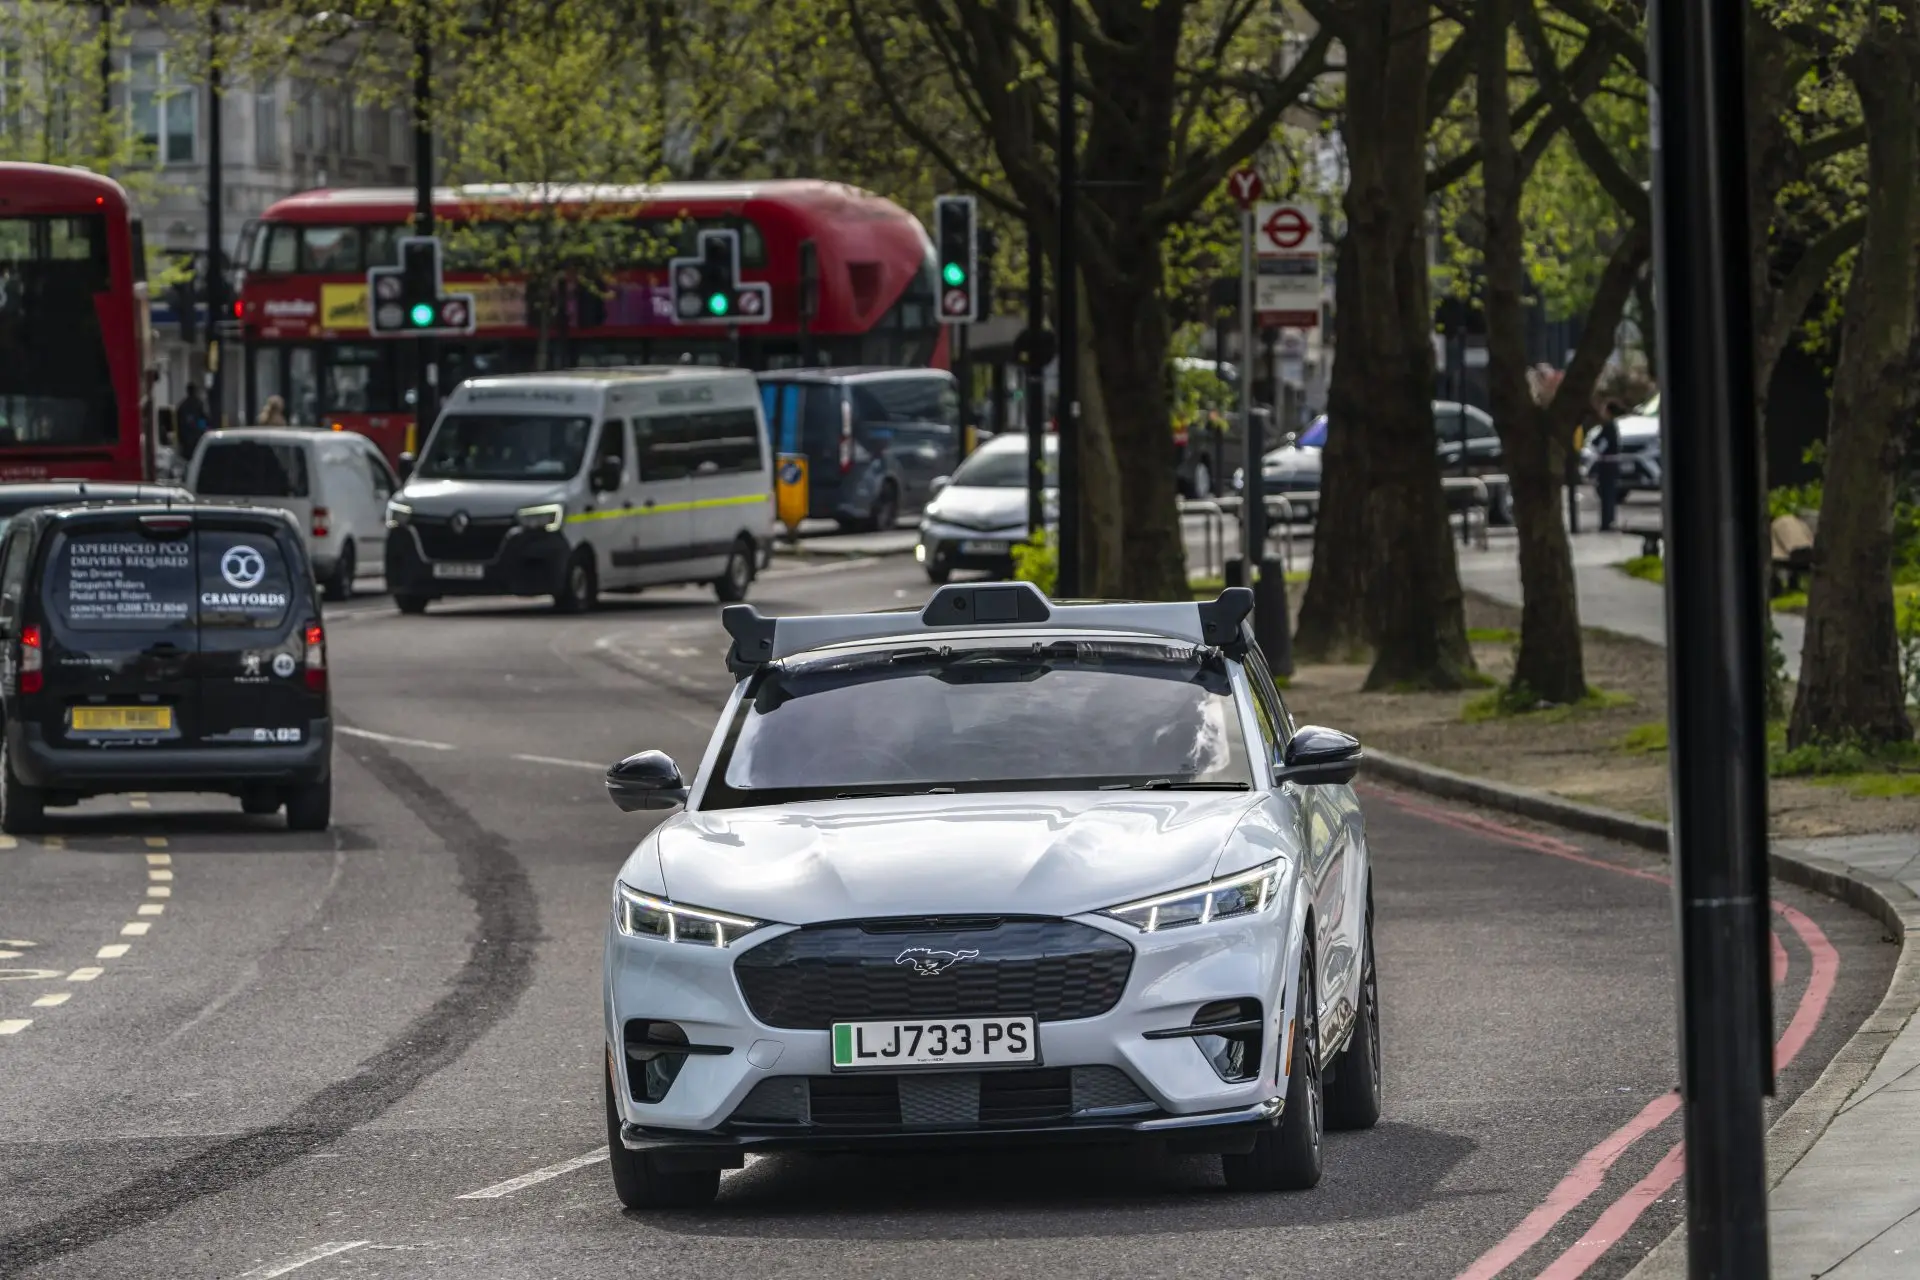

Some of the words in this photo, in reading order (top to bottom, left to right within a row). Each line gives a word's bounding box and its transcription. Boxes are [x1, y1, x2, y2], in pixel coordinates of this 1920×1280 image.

[1235, 172, 1256, 198] Y
[70, 543, 156, 554] EXPERIENCED
[159, 542, 189, 554] PCO
[70, 555, 123, 567] DRIVERS
[125, 555, 189, 569] REQUIRED
[201, 592, 286, 605] CRAWFORDS
[856, 1024, 971, 1058] LJ733
[983, 1022, 1028, 1055] PS
